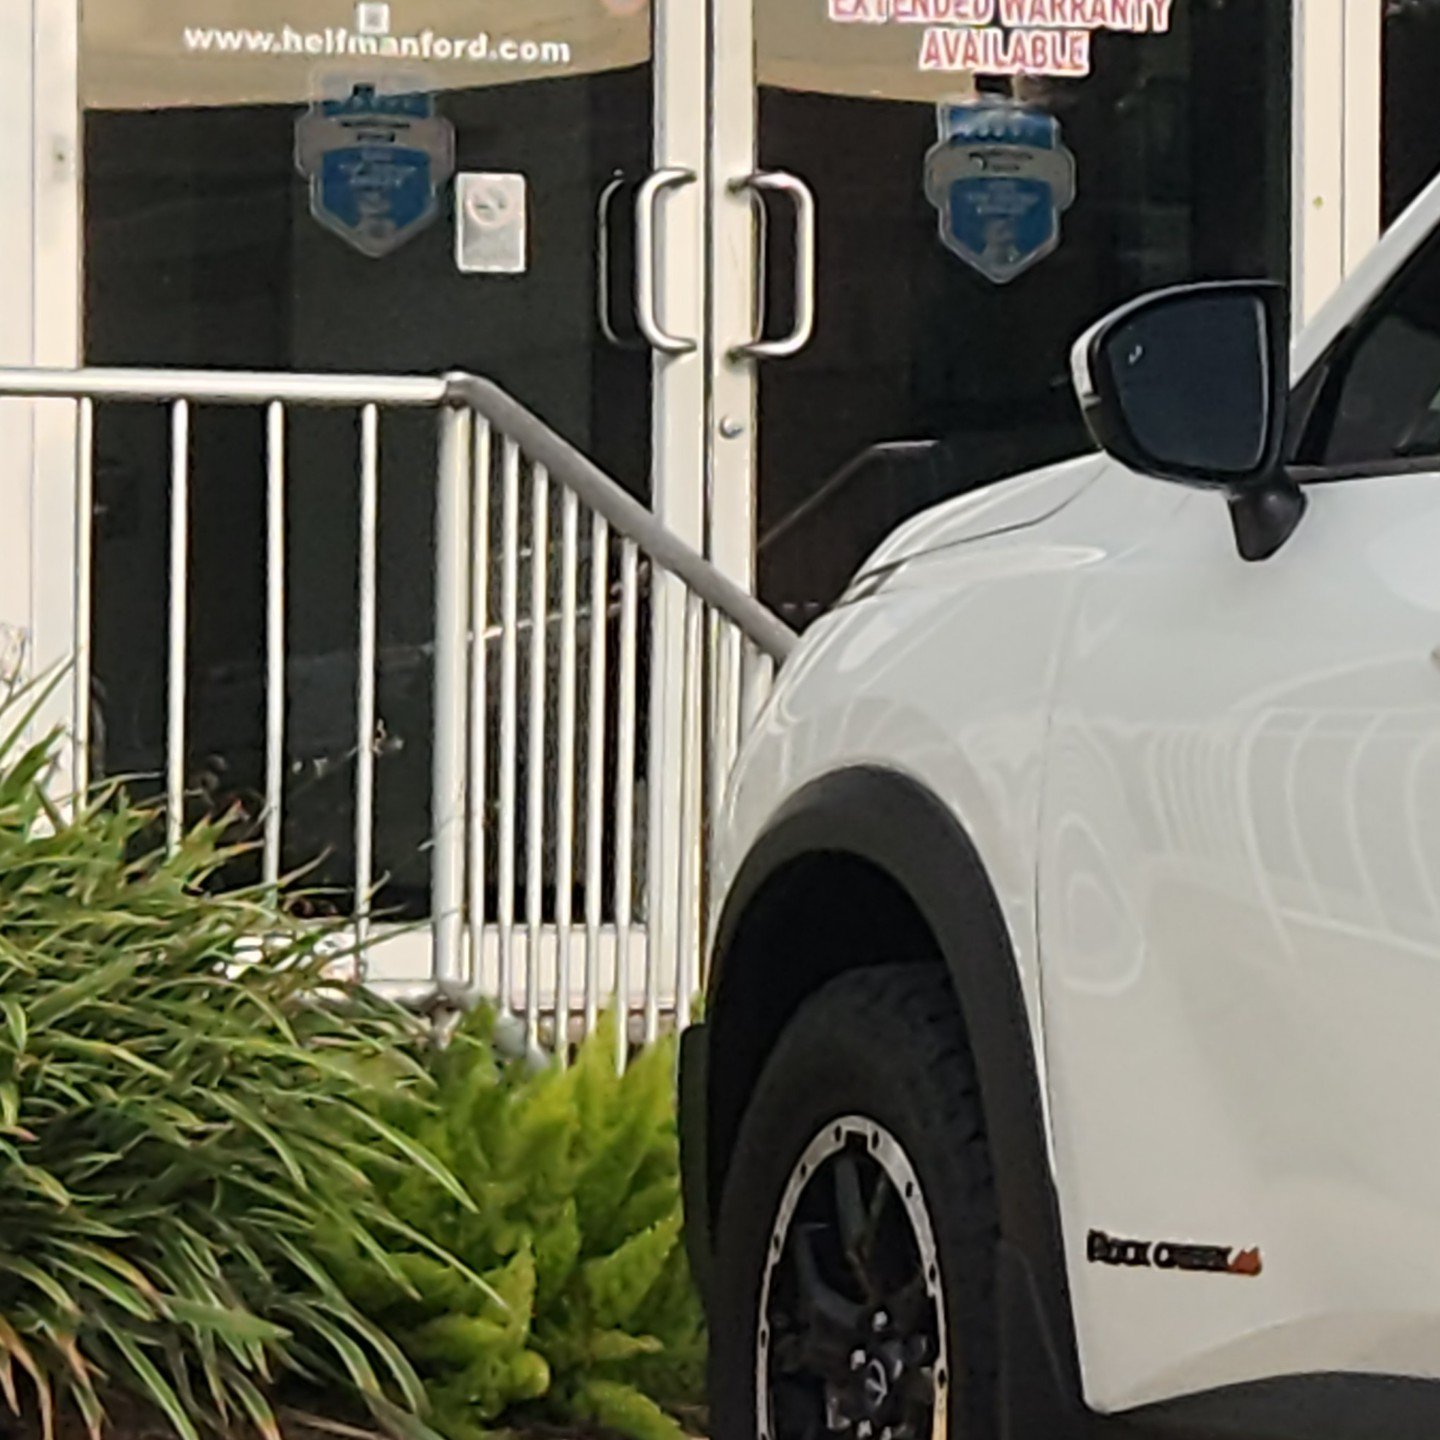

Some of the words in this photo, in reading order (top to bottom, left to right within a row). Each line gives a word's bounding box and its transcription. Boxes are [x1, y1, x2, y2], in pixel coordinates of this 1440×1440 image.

[184, 25, 572, 63] www.helfmanford.com
[922, 31, 1086, 72] AVAILABLE
[1086, 1228, 1151, 1267] ROCK
